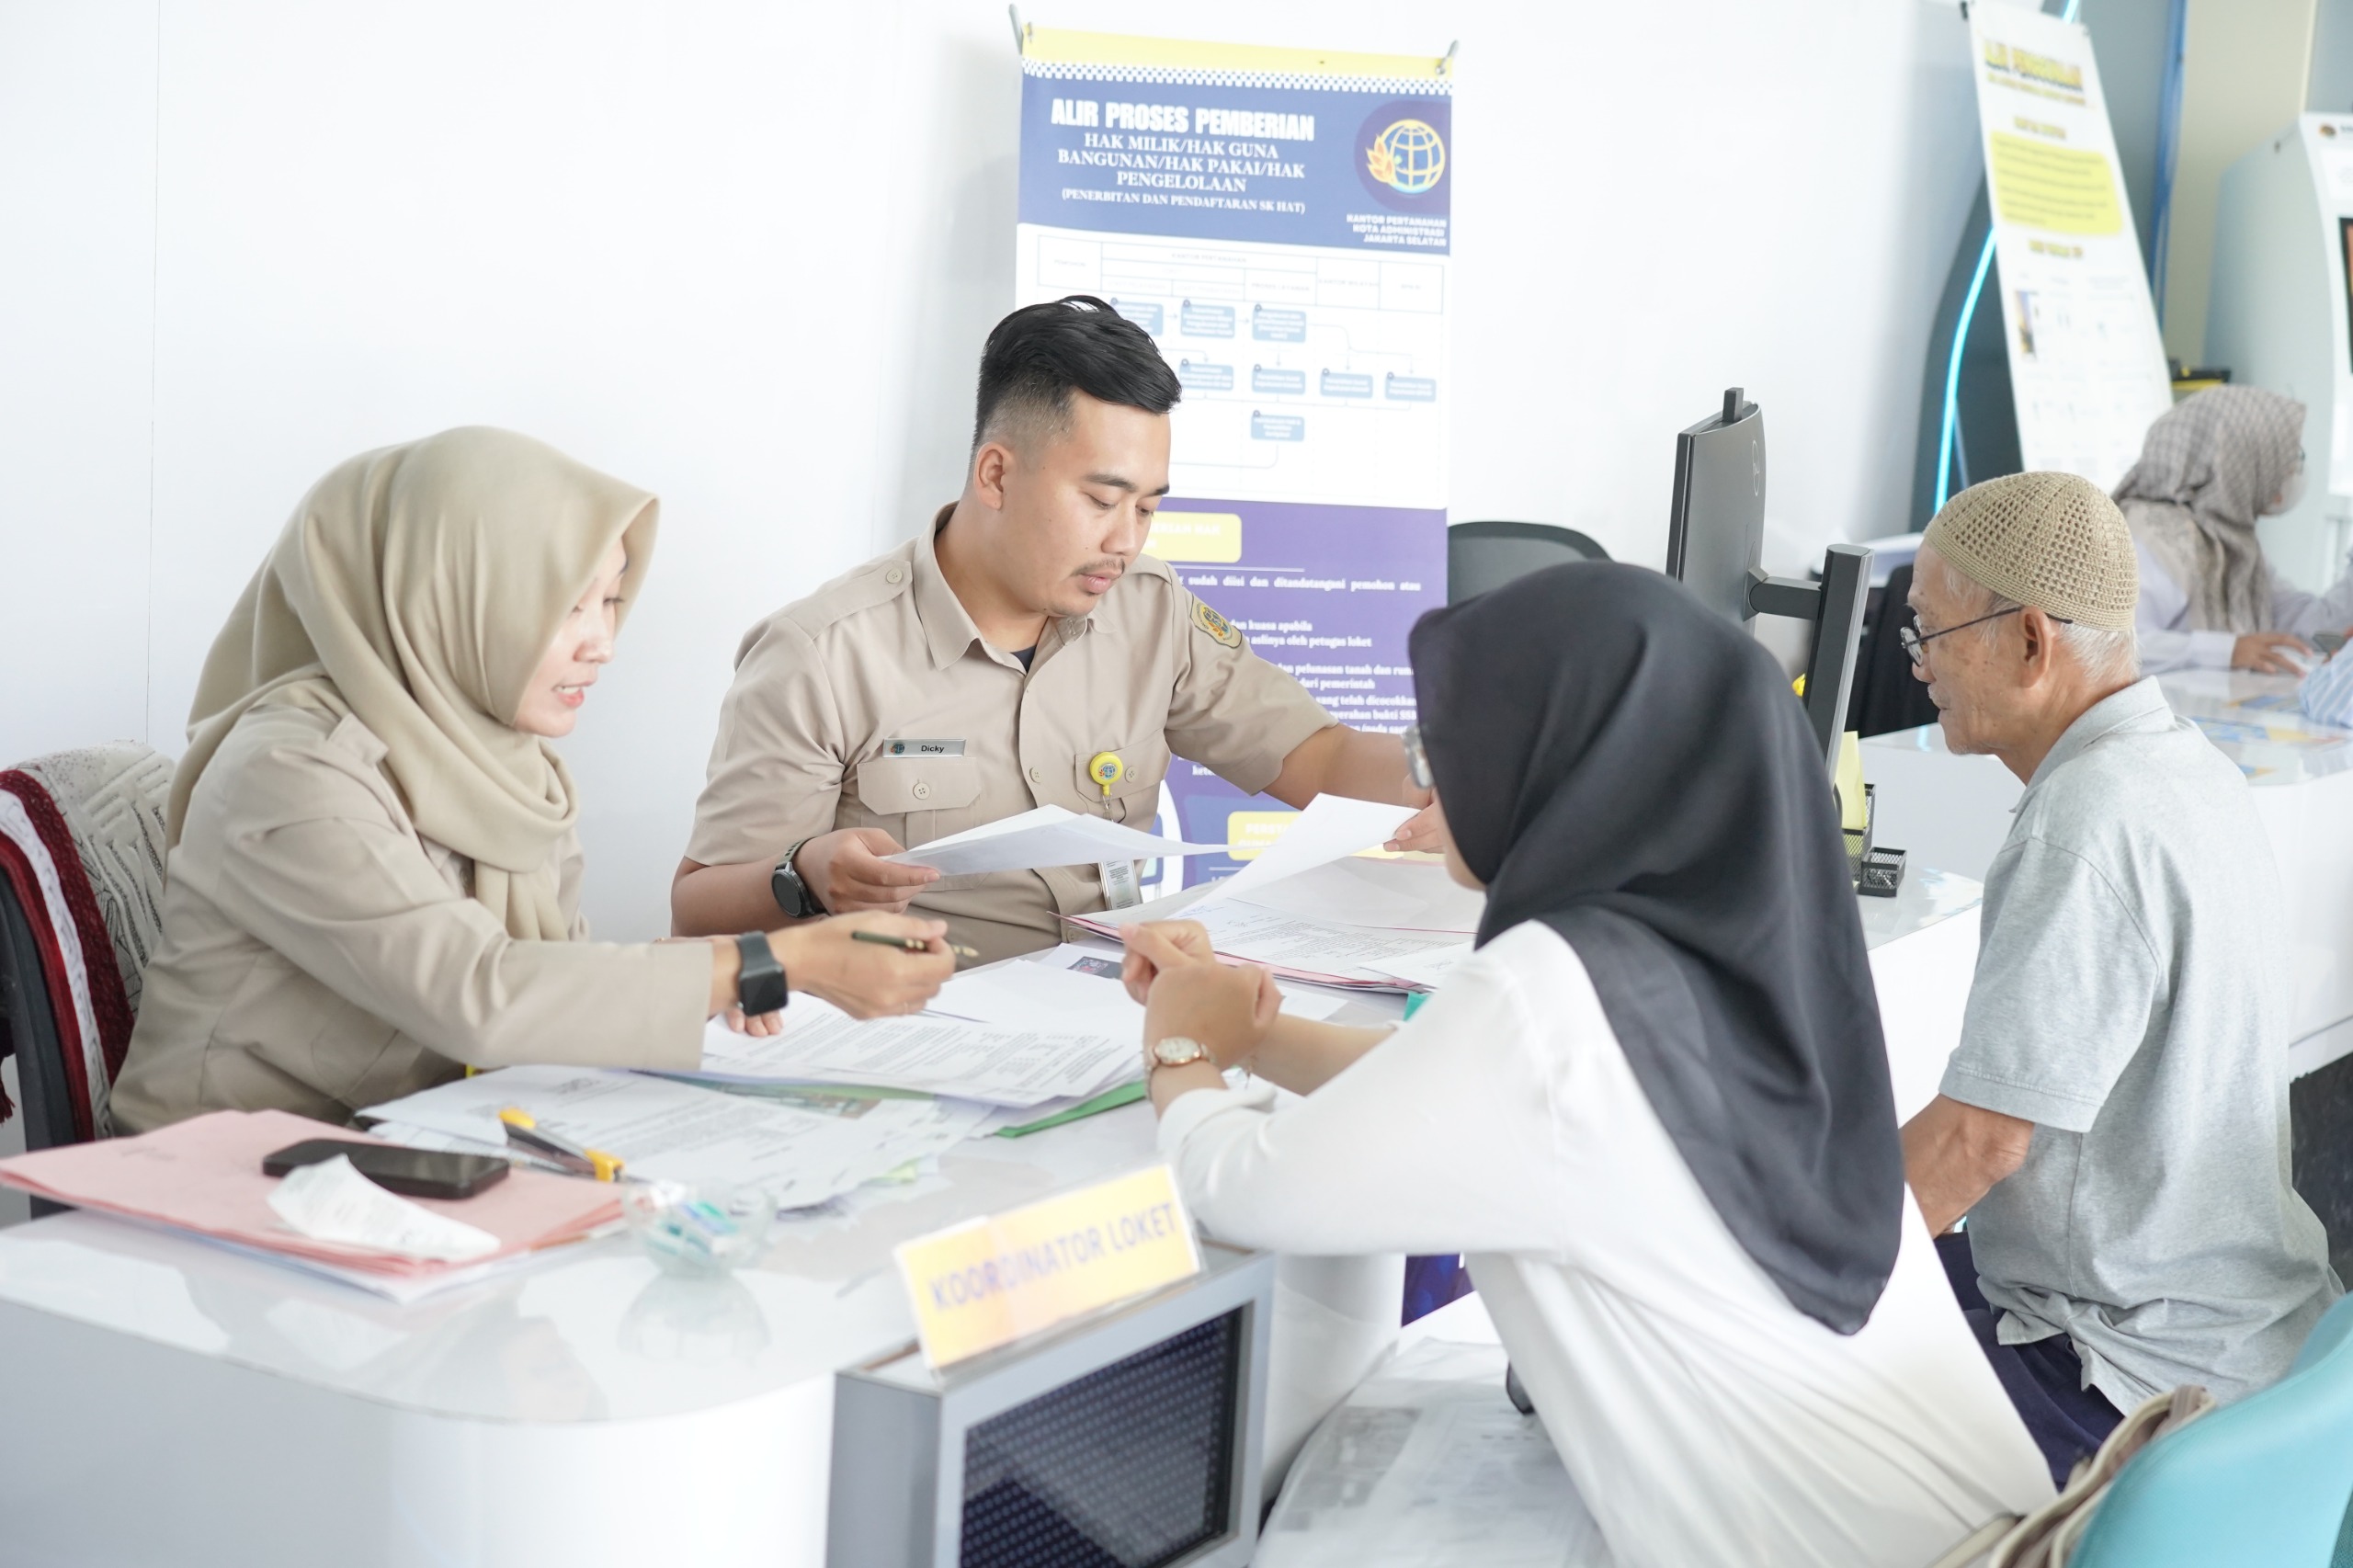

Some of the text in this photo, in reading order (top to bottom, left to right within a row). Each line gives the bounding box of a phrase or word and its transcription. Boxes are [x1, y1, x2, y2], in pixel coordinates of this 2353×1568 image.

[1051, 98, 1315, 142] ALIR PROSES PEMBERIAN
[1085, 132, 1279, 159] HAK MILIK/HAK GUNA
[1057, 149, 1305, 178] BANGUNAN/HAK PAKAI/HAK
[1117, 171, 1246, 192] PENGELOLAAN
[1062, 187, 1306, 215] (PENERBITAN DAN PENDAFTARAN SK HAT)
[1346, 213, 1447, 228] KANTOR PERTANAHAN
[1352, 223, 1445, 237] KOTA ADMINISTRASI
[1363, 233, 1447, 246] JAKARTA SELATAN
[1249, 576, 1268, 587] dan
[921, 744, 945, 754] Dicky
[930, 1201, 1176, 1311] KOORDINATOR LOKET
